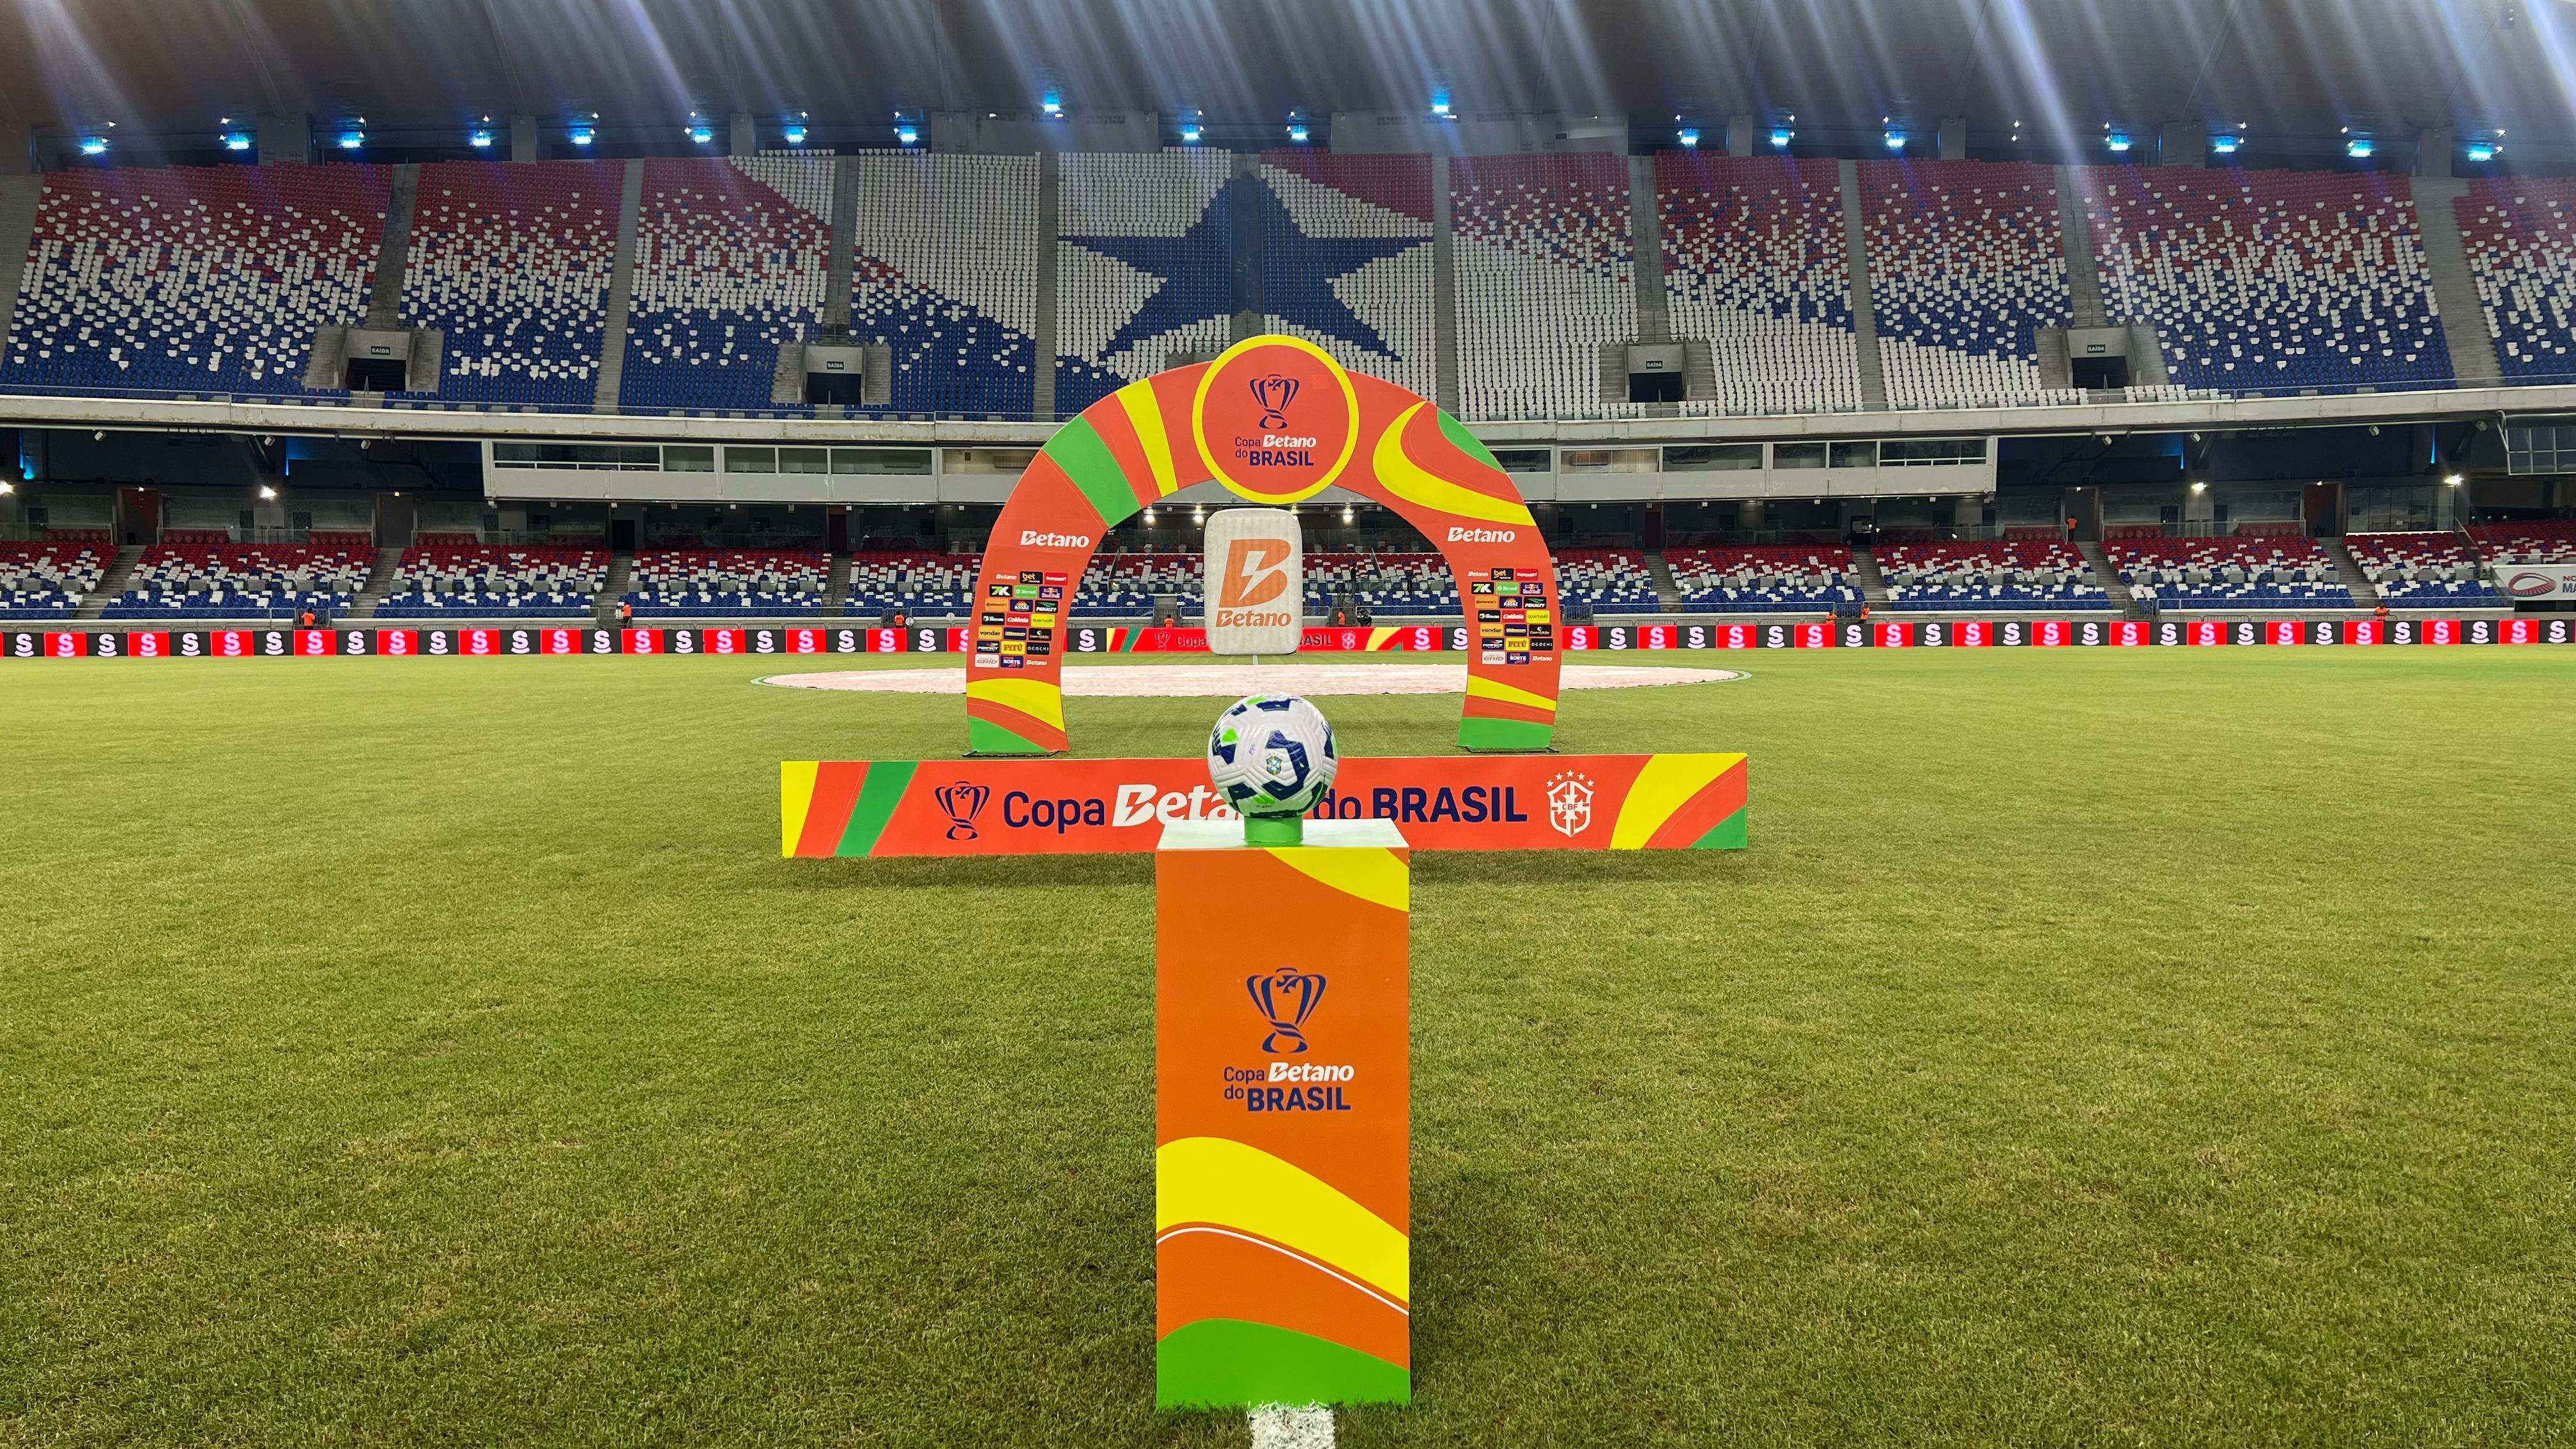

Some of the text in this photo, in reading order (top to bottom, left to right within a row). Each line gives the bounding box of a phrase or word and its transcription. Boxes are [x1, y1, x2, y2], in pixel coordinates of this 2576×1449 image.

[1235, 434, 1317, 448] Copa Betano
[1235, 448, 1314, 466] do BRASIL
[1020, 530, 1089, 548] Betano
[1447, 526, 1515, 543] Betano
[992, 586, 1011, 596] 7K
[1473, 583, 1492, 593] 7K
[1216, 610, 1291, 627] Betano
[1176, 635, 1207, 648] Copa
[1300, 634, 1333, 646] ASIL
[1004, 784, 1528, 834] Copa Beta do BRASIL
[1223, 1062, 1354, 1084] Copa Betano
[1224, 1085, 1351, 1111] do BRASIL
